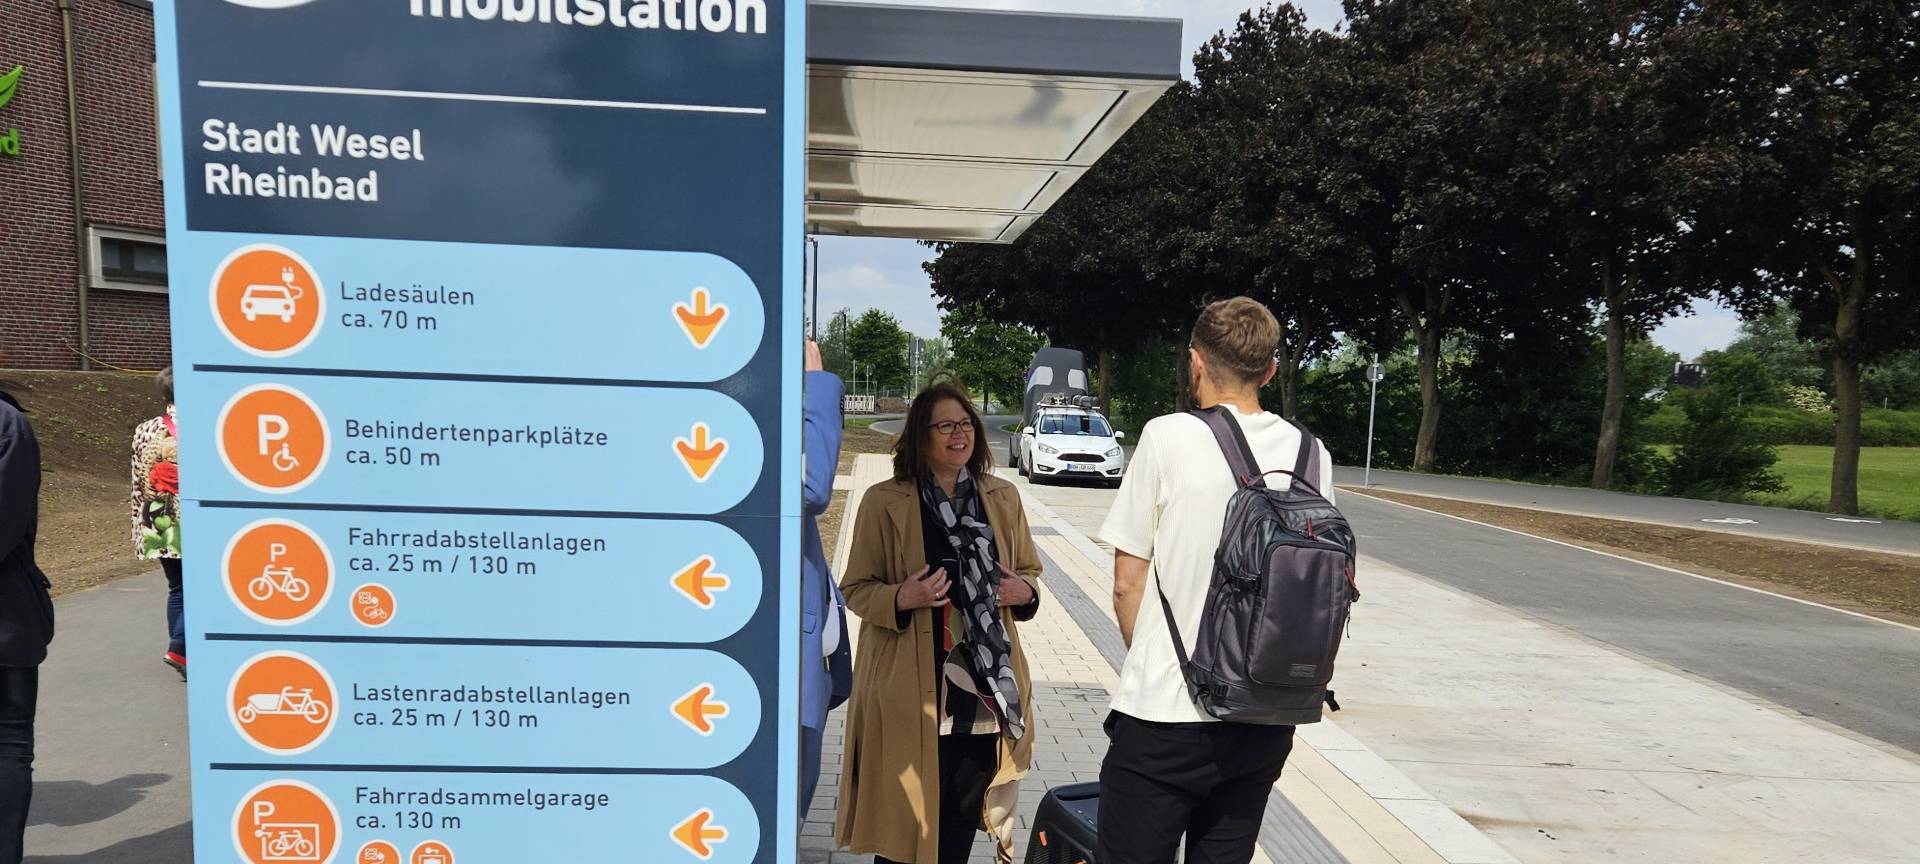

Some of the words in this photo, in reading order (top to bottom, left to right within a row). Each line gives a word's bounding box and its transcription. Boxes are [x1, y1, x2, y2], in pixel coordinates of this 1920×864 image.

[202, 118, 301, 155] Stadt
[311, 124, 425, 161] Wesel
[204, 163, 378, 202] Rheinbad
[340, 281, 475, 306] Ladesäulen
[341, 313, 373, 329] ca.
[381, 309, 408, 330] 70
[417, 316, 437, 331] m
[345, 419, 609, 449] Behindertenparkplätze
[346, 450, 377, 465] ca.
[385, 446, 412, 466] 50
[420, 452, 440, 466] m
[349, 527, 606, 556] Fahrradabstellanlagen
[349, 557, 380, 572] ca.
[388, 553, 414, 572] 25
[422, 559, 442, 573] m
[450, 554, 460, 574] /
[469, 555, 508, 575] 130
[516, 561, 537, 576] m
[353, 682, 631, 709] Lastenradabstellanlagen
[353, 712, 384, 727] ca.
[391, 707, 418, 727] 25
[426, 713, 446, 727] m
[453, 708, 462, 728] /
[472, 709, 510, 728] 130
[518, 714, 539, 729] m
[356, 786, 610, 811] Fahrradsammelgarage
[356, 815, 386, 829] ca.
[395, 811, 433, 829] 130
[441, 816, 461, 830] m
